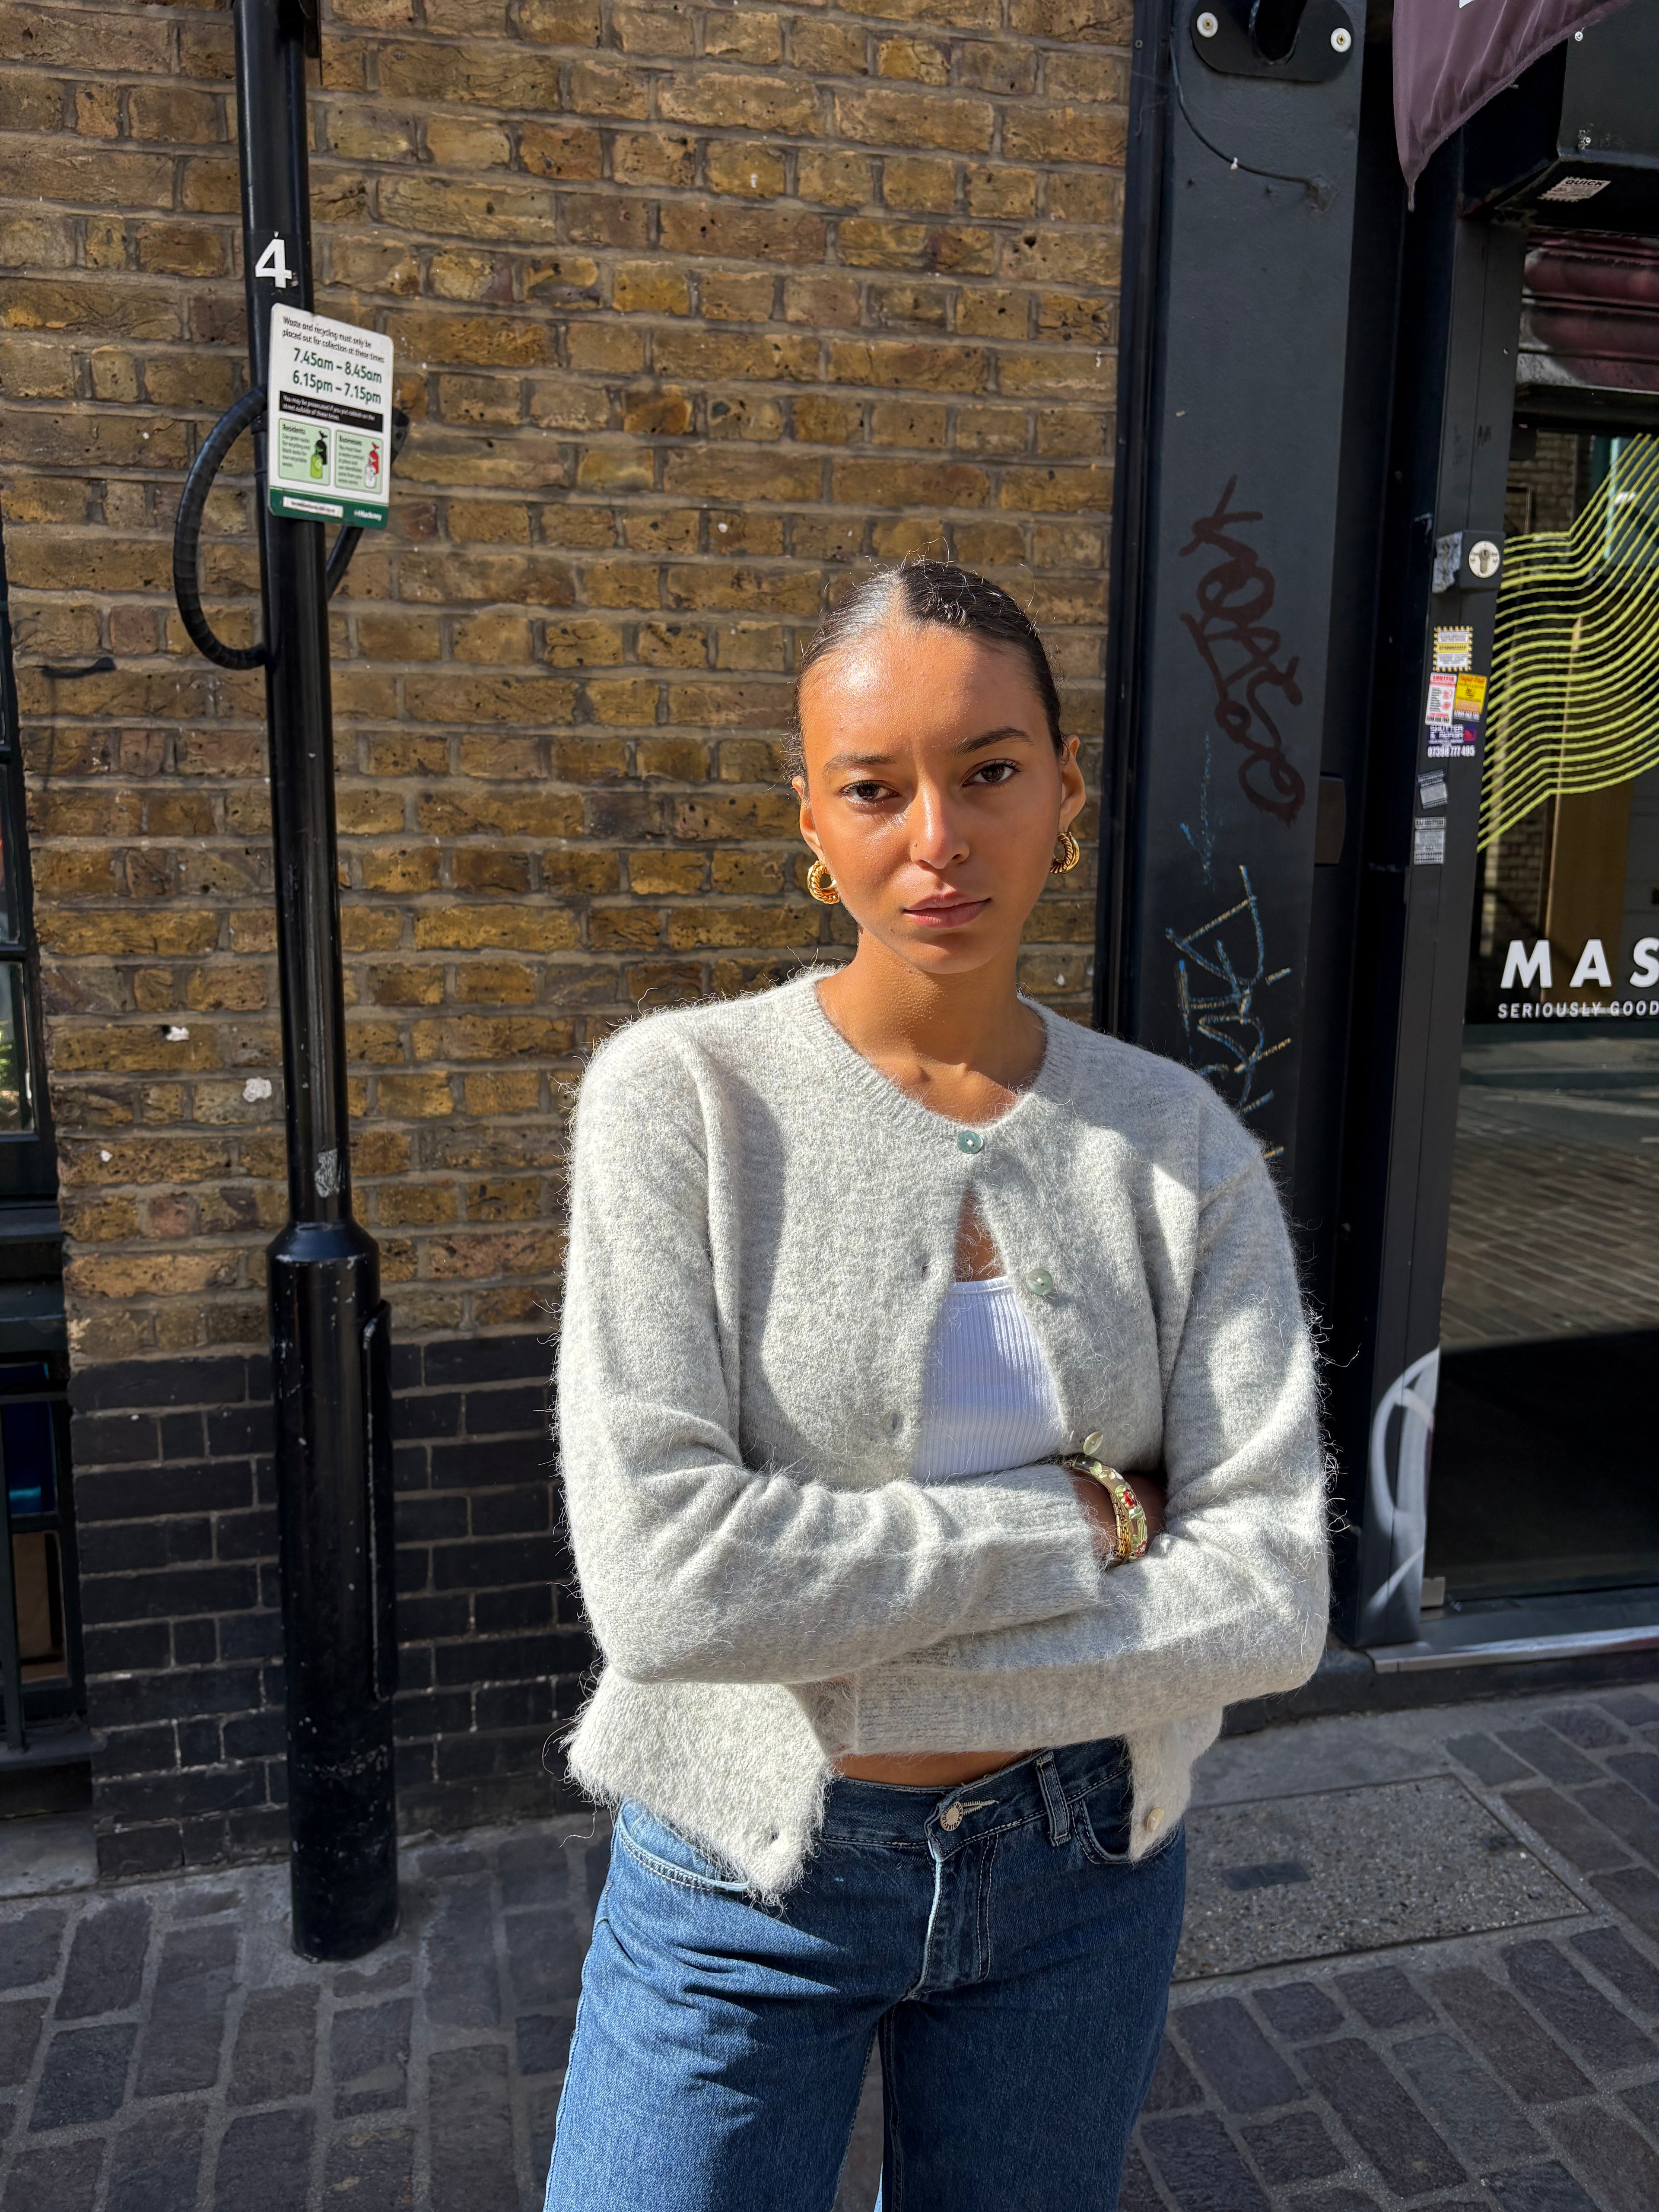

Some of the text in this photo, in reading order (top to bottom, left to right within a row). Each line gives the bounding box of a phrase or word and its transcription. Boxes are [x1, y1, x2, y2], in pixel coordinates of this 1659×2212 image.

[255, 238, 292, 288] 4
[282, 328, 302, 340] placed
[313, 336, 321, 345] for
[321, 340, 347, 353] collection
[355, 349, 369, 359] these
[283, 316, 301, 328] Waste
[314, 327, 338, 340] recycling
[339, 334, 352, 343] must
[353, 338, 364, 348] only
[364, 340, 372, 349] be
[294, 347, 334, 371] 7.45am
[345, 361, 382, 383] 8.45am
[293, 370, 333, 393] 6.15pm
[344, 383, 381, 404] 7.15pm
[1500, 937, 1659, 988] MAS
[1497, 1000, 1659, 1019] SERIOUSLY GOOD
